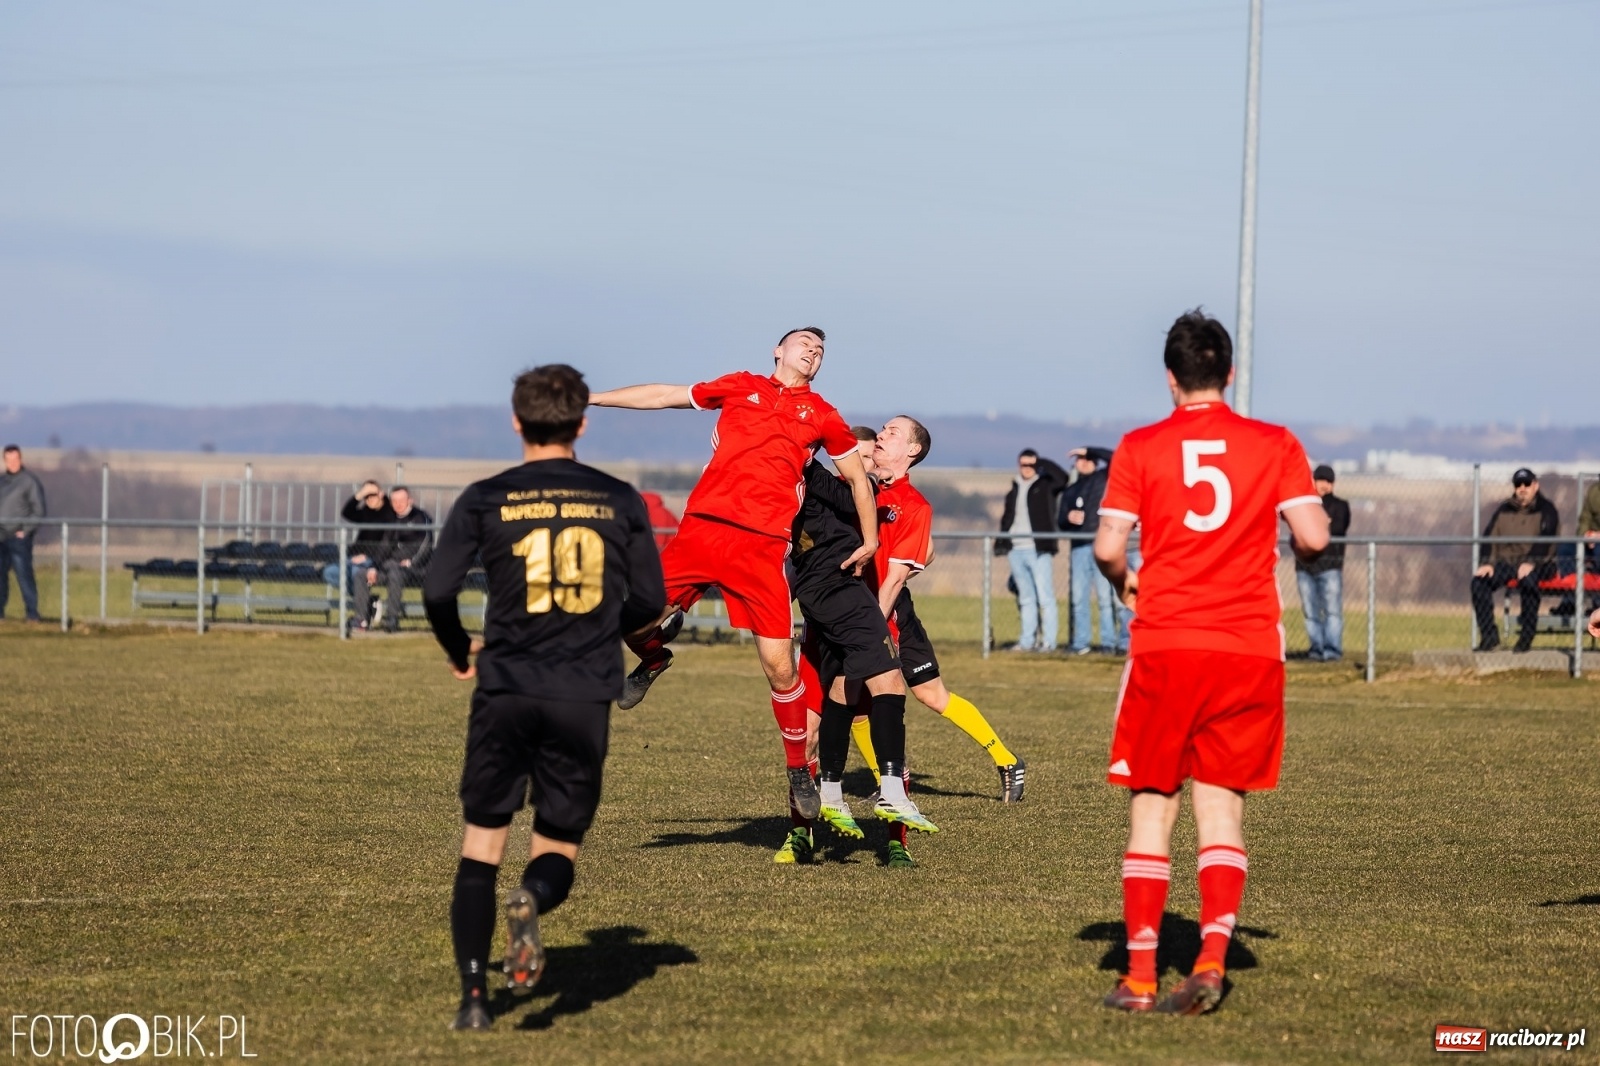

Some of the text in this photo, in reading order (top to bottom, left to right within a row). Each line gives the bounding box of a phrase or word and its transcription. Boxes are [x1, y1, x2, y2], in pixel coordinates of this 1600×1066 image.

[1181, 439, 1233, 532] 5
[886, 509, 897, 521] 16
[511, 526, 605, 614] 19
[912, 661, 932, 674] zina
